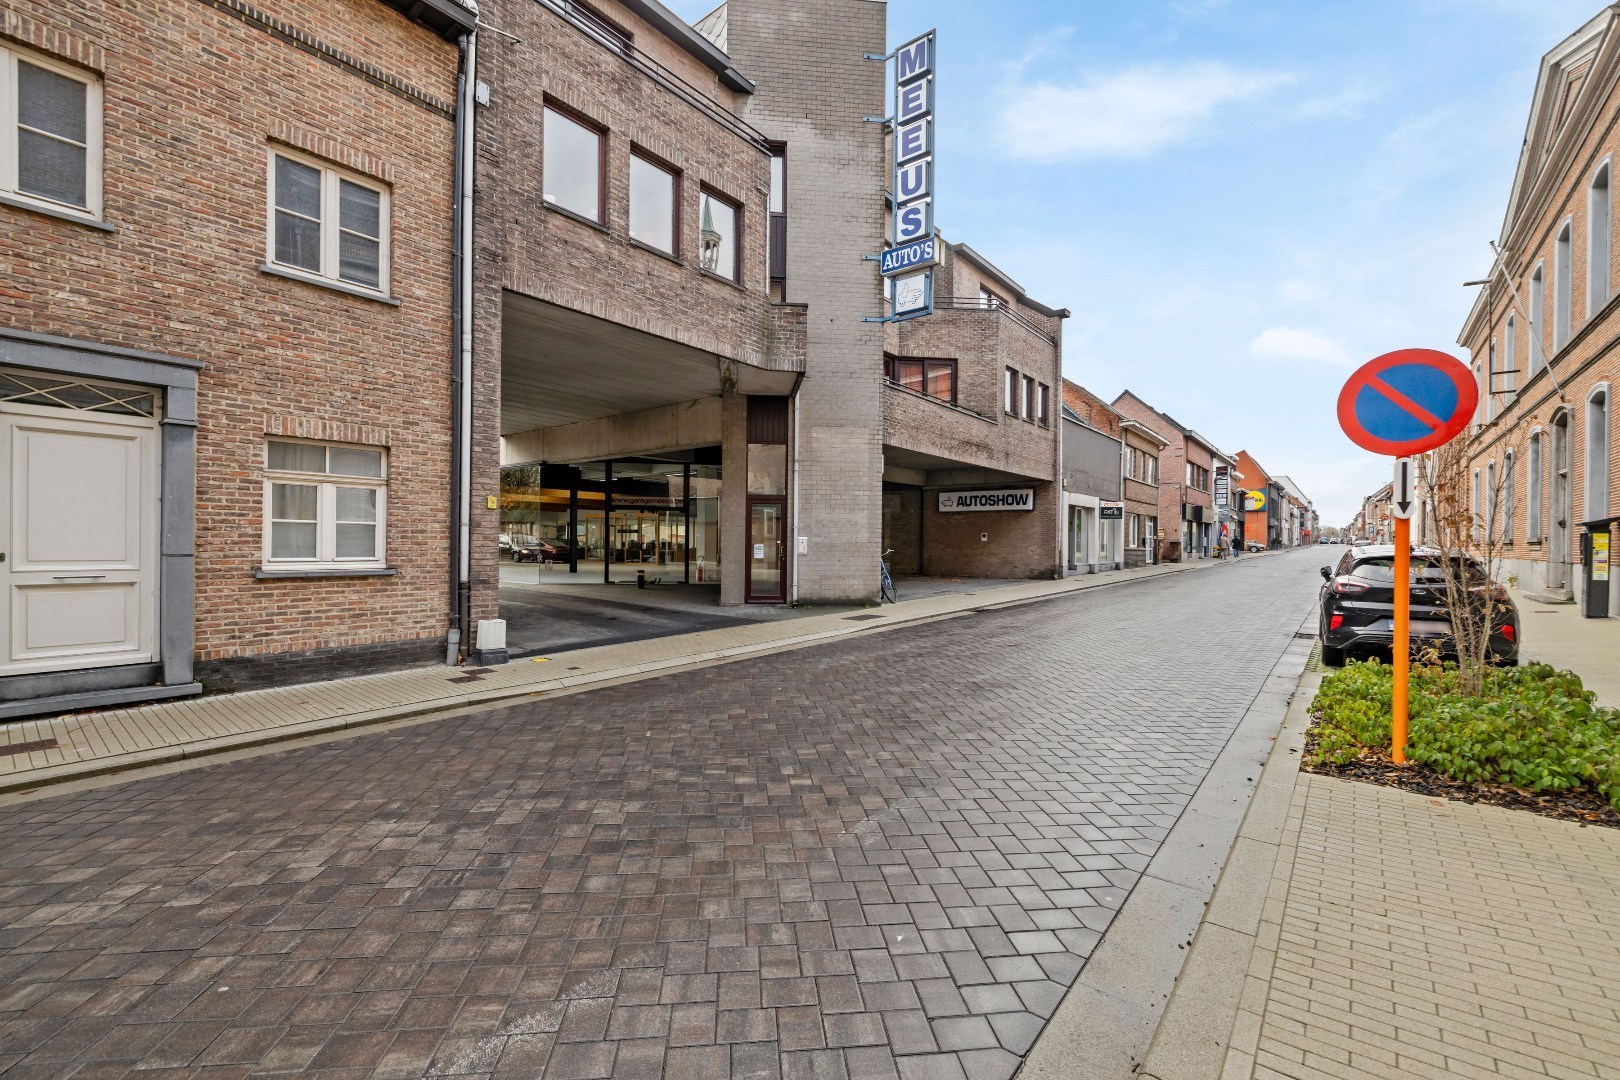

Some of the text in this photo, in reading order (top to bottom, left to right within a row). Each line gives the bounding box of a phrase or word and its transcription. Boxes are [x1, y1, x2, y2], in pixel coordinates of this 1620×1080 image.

[899, 40, 926, 237] MEEUS
[882, 241, 934, 271] AUTO'S
[956, 494, 1029, 508] AUTOSHOW
